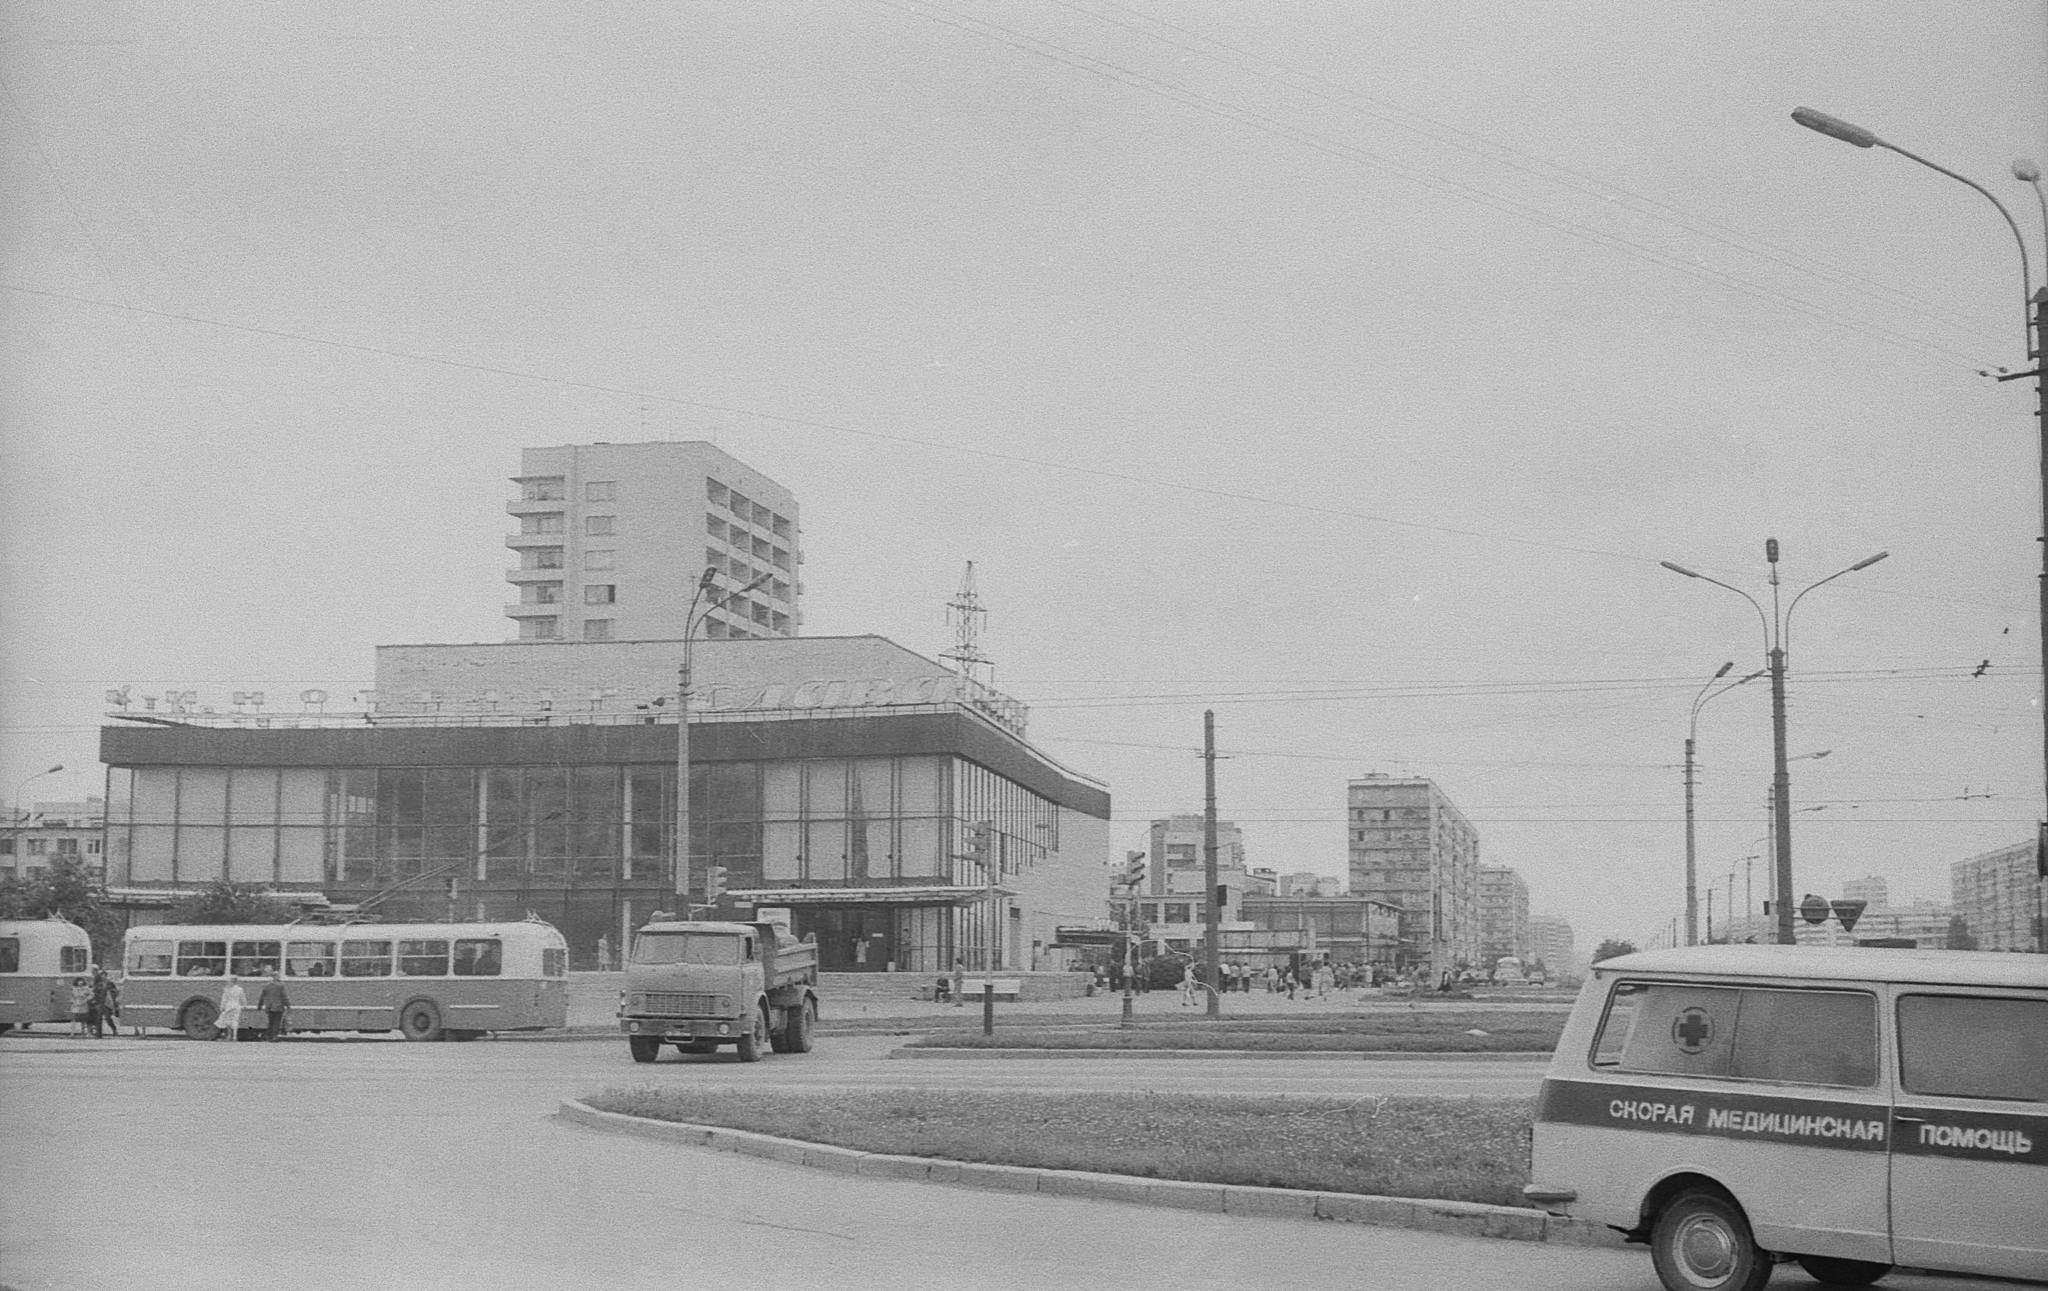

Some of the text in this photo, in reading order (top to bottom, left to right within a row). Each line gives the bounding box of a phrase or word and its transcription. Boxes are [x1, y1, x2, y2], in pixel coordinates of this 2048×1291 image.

[1608, 1099, 2033, 1154] СКОРАЯ МЕДИЦИНСКАЯ ПОМОЩЬ
